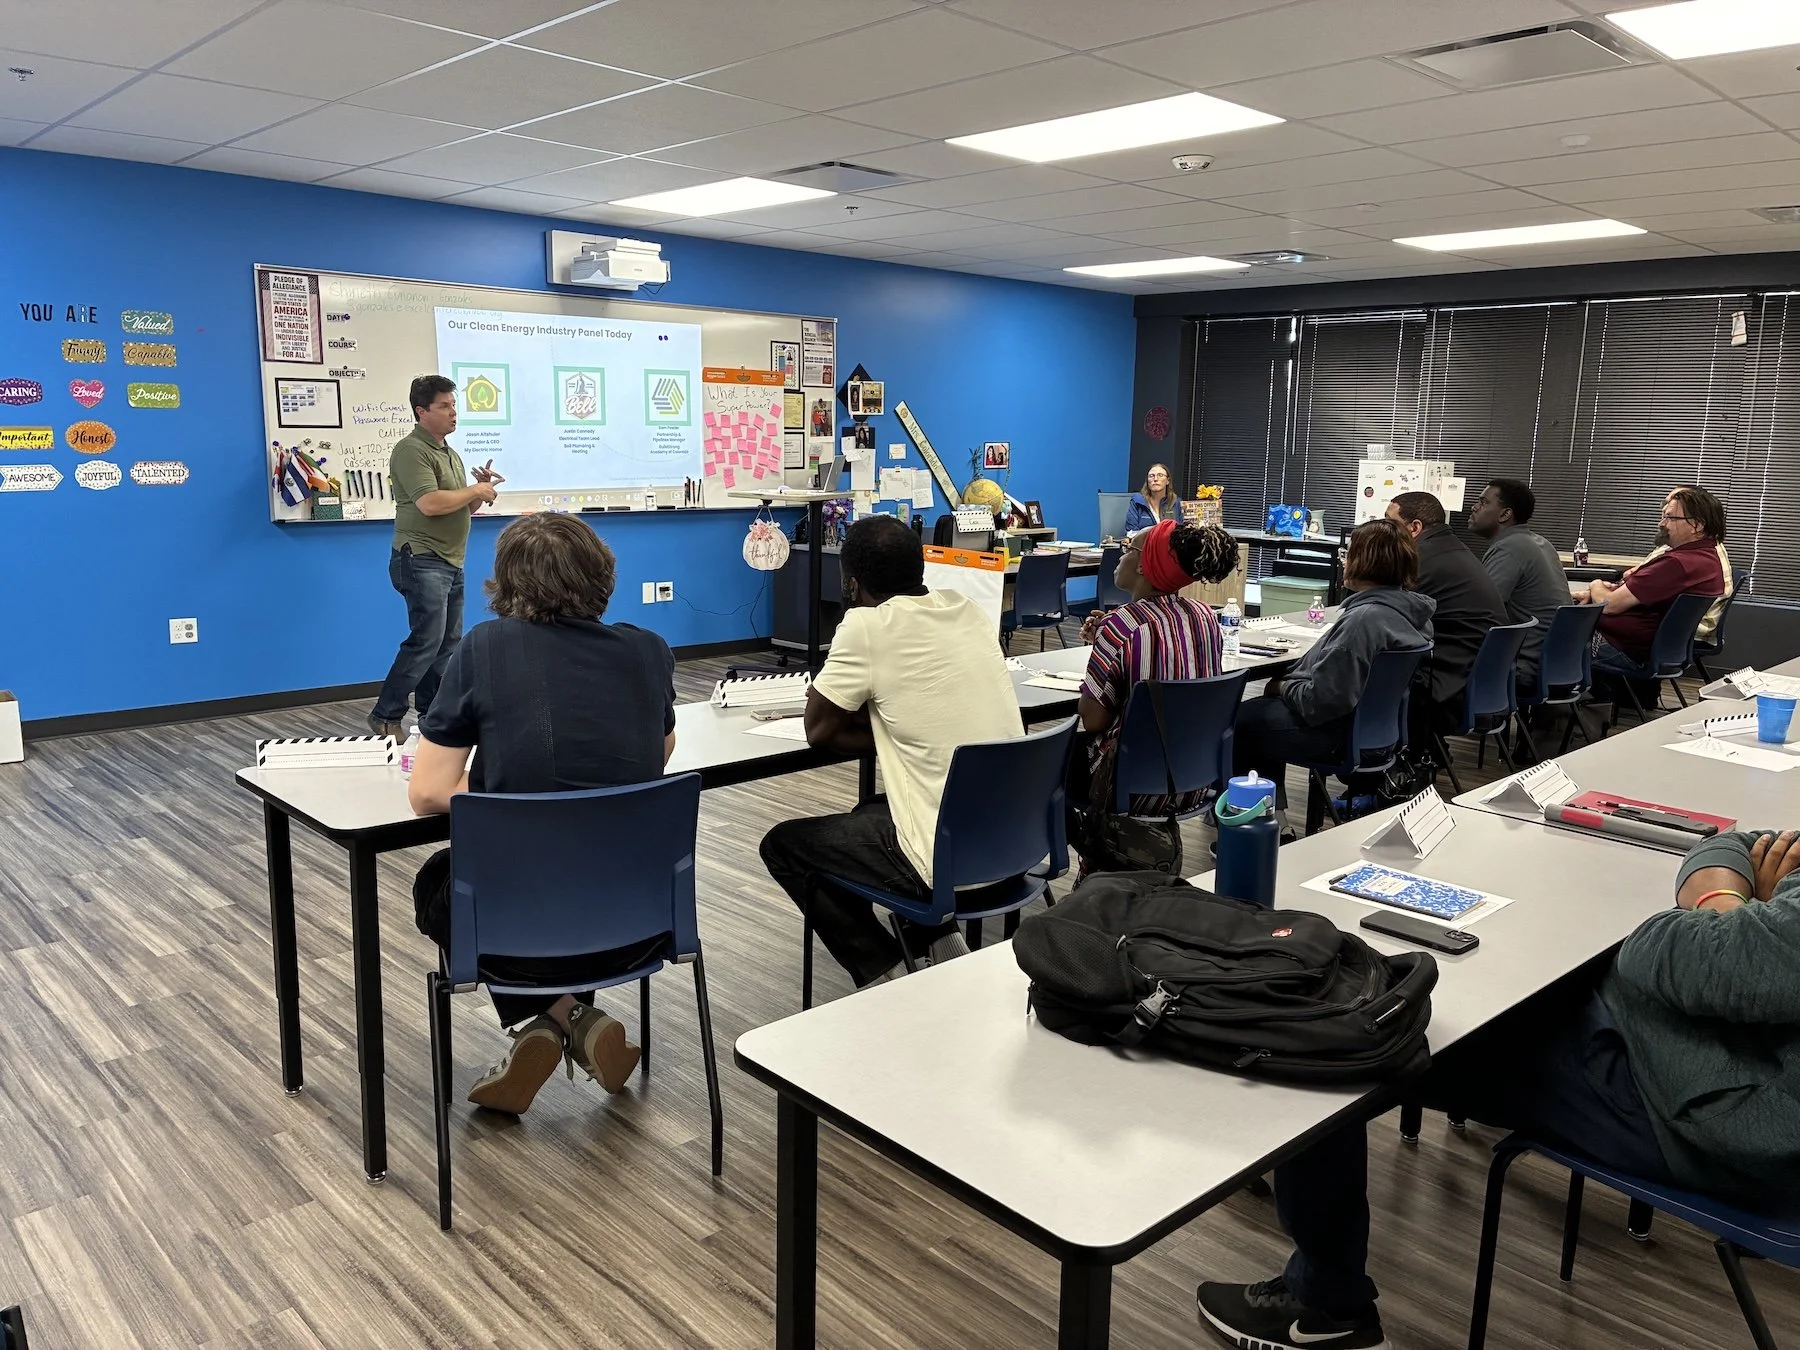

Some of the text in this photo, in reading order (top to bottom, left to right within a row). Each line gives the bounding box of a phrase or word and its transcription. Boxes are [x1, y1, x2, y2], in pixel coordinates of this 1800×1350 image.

[273, 283, 306, 291] ALLEGIANCE
[20, 303, 98, 323] YOU ARE
[274, 306, 308, 316] AMERICA
[124, 315, 170, 330] Valued
[448, 320, 632, 341] Our Clean Energy Industry Panel Today
[68, 342, 102, 360] Funny
[127, 347, 173, 363] Capable
[0, 387, 37, 397] CARING
[73, 386, 104, 398] Loved
[131, 389, 177, 401] Positive
[708, 385, 777, 400] What Is Your
[380, 402, 406, 412] Guest
[717, 399, 770, 415] Super Power?
[72, 430, 111, 445] Honest
[919, 440, 938, 470] Colorado
[9, 473, 55, 482] AWESOME
[82, 472, 116, 481] JOYFUL
[136, 468, 185, 479] TALENTED
[749, 543, 782, 563] thankful
